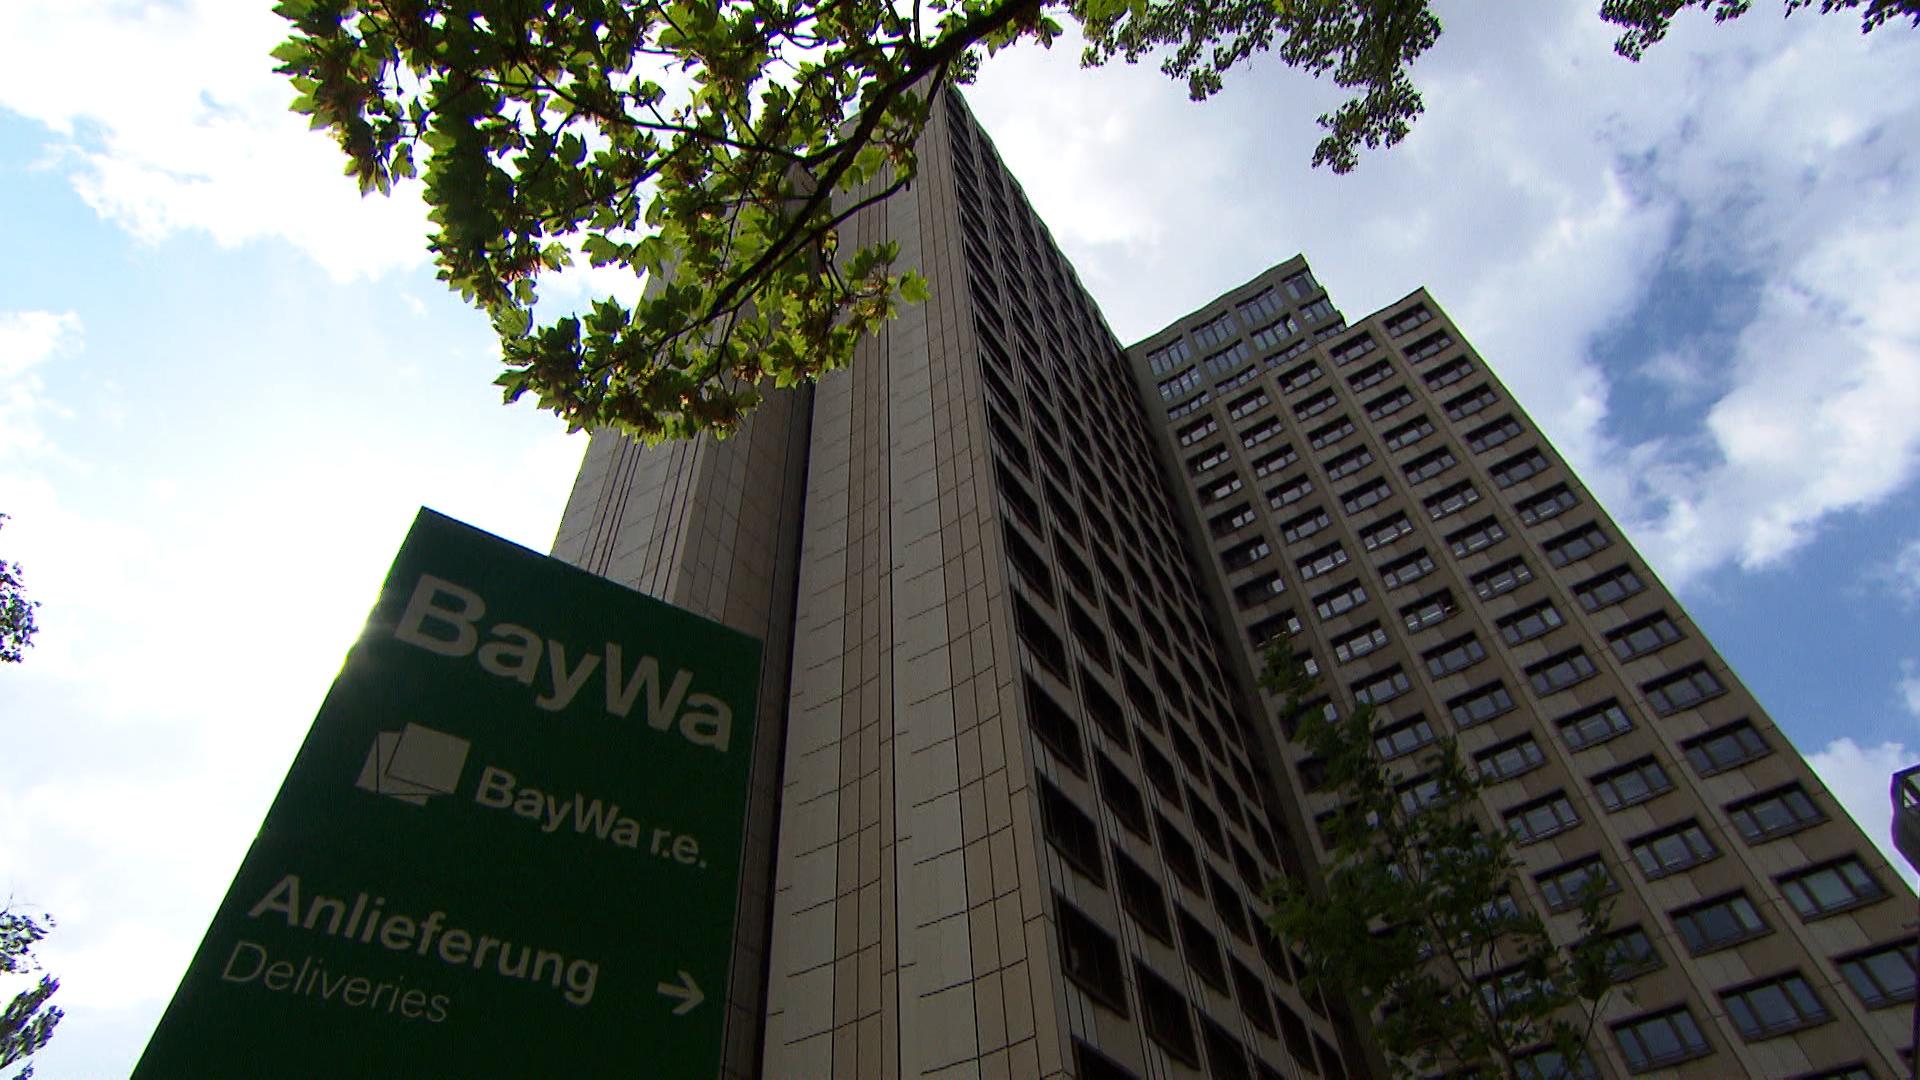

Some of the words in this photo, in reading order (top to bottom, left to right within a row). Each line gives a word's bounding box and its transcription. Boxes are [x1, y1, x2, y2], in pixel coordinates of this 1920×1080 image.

[394, 573, 732, 752] BayWa
[475, 766, 641, 848] BayWa
[650, 827, 708, 868] r.e.
[222, 940, 451, 1022] Deliveries
[248, 874, 599, 1005] Anlieferung
